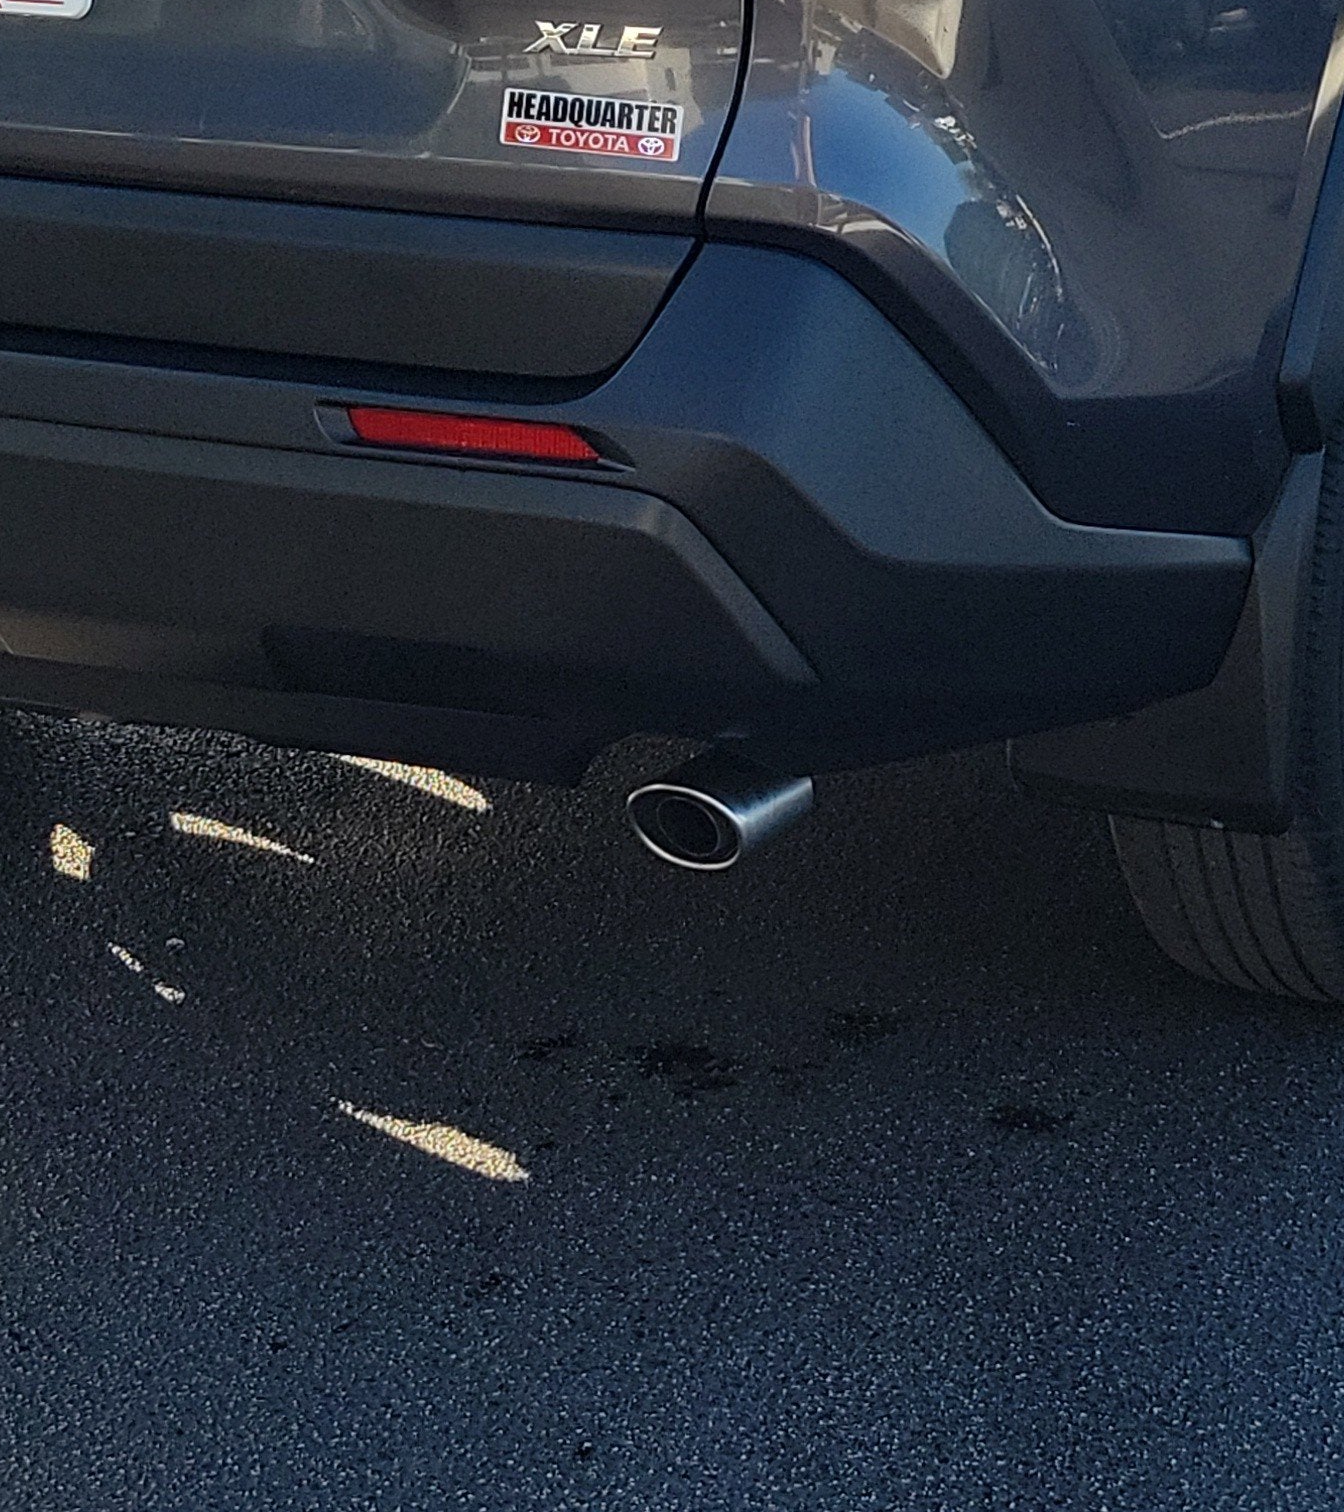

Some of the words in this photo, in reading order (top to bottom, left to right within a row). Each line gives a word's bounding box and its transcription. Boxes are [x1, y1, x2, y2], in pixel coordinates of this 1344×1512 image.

[522, 20, 664, 59] XLE
[507, 91, 677, 135] HEADQUARTER
[548, 128, 630, 153] TOYOTA
